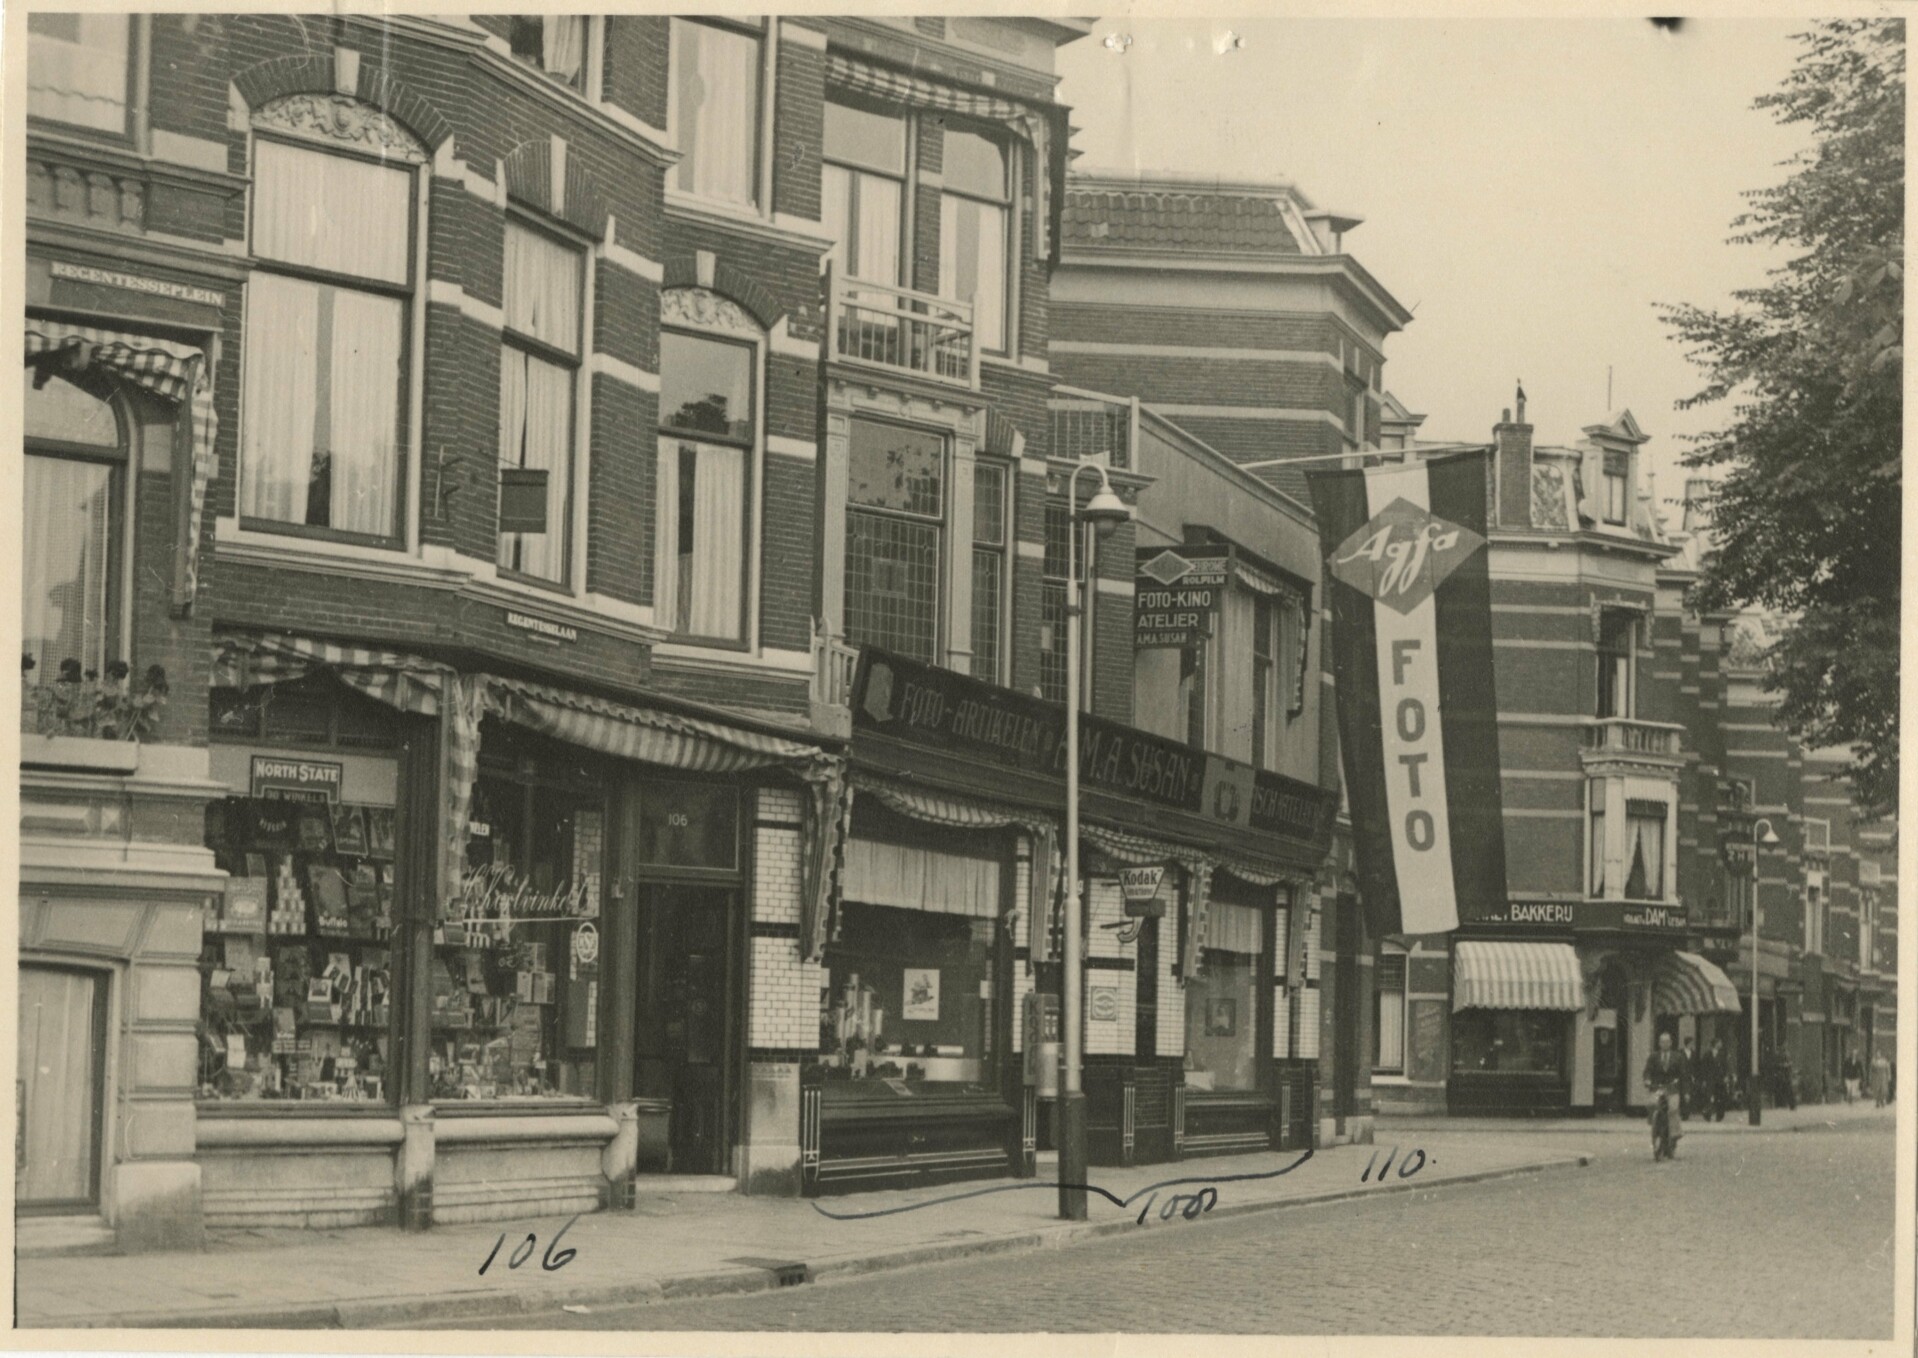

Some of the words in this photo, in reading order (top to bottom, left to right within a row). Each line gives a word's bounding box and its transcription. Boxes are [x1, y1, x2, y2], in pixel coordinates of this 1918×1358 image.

[1336, 523, 1460, 597] Agfa
[1138, 591, 1211, 608] FOTO-KINO
[1138, 613, 1198, 628] ATELIER
[1391, 639, 1435, 852] FOTO
[668, 813, 688, 827] 106
